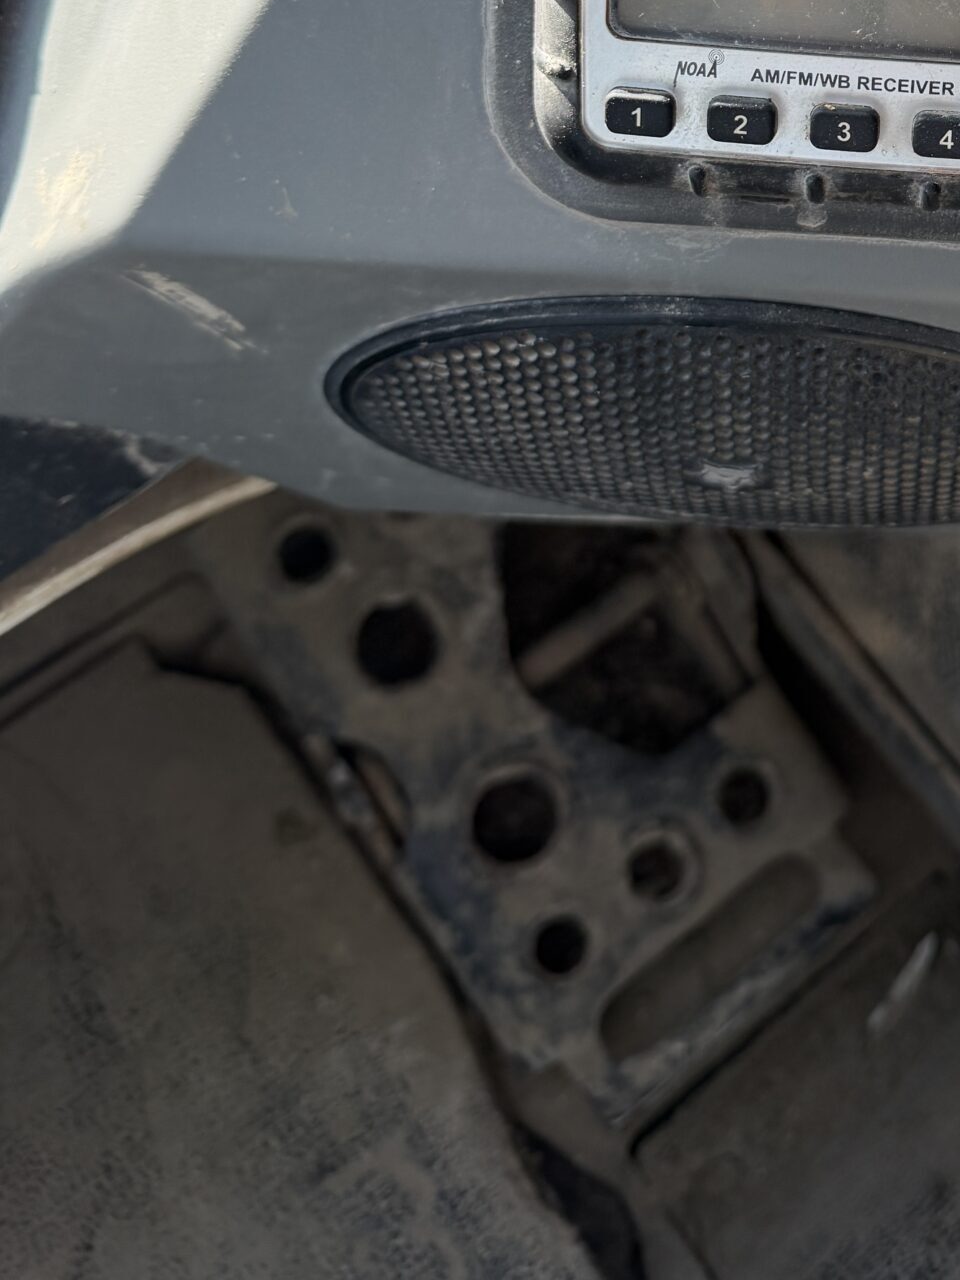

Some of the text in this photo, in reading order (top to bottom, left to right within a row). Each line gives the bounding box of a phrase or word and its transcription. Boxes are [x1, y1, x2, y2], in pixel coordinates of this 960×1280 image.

[674, 61, 718, 87] NOAA
[750, 68, 955, 96] AM/FM/WB RECEIVER
[630, 107, 642, 127] 1
[734, 115, 748, 135] 2
[837, 122, 851, 141] 3
[939, 129, 954, 150] 4
